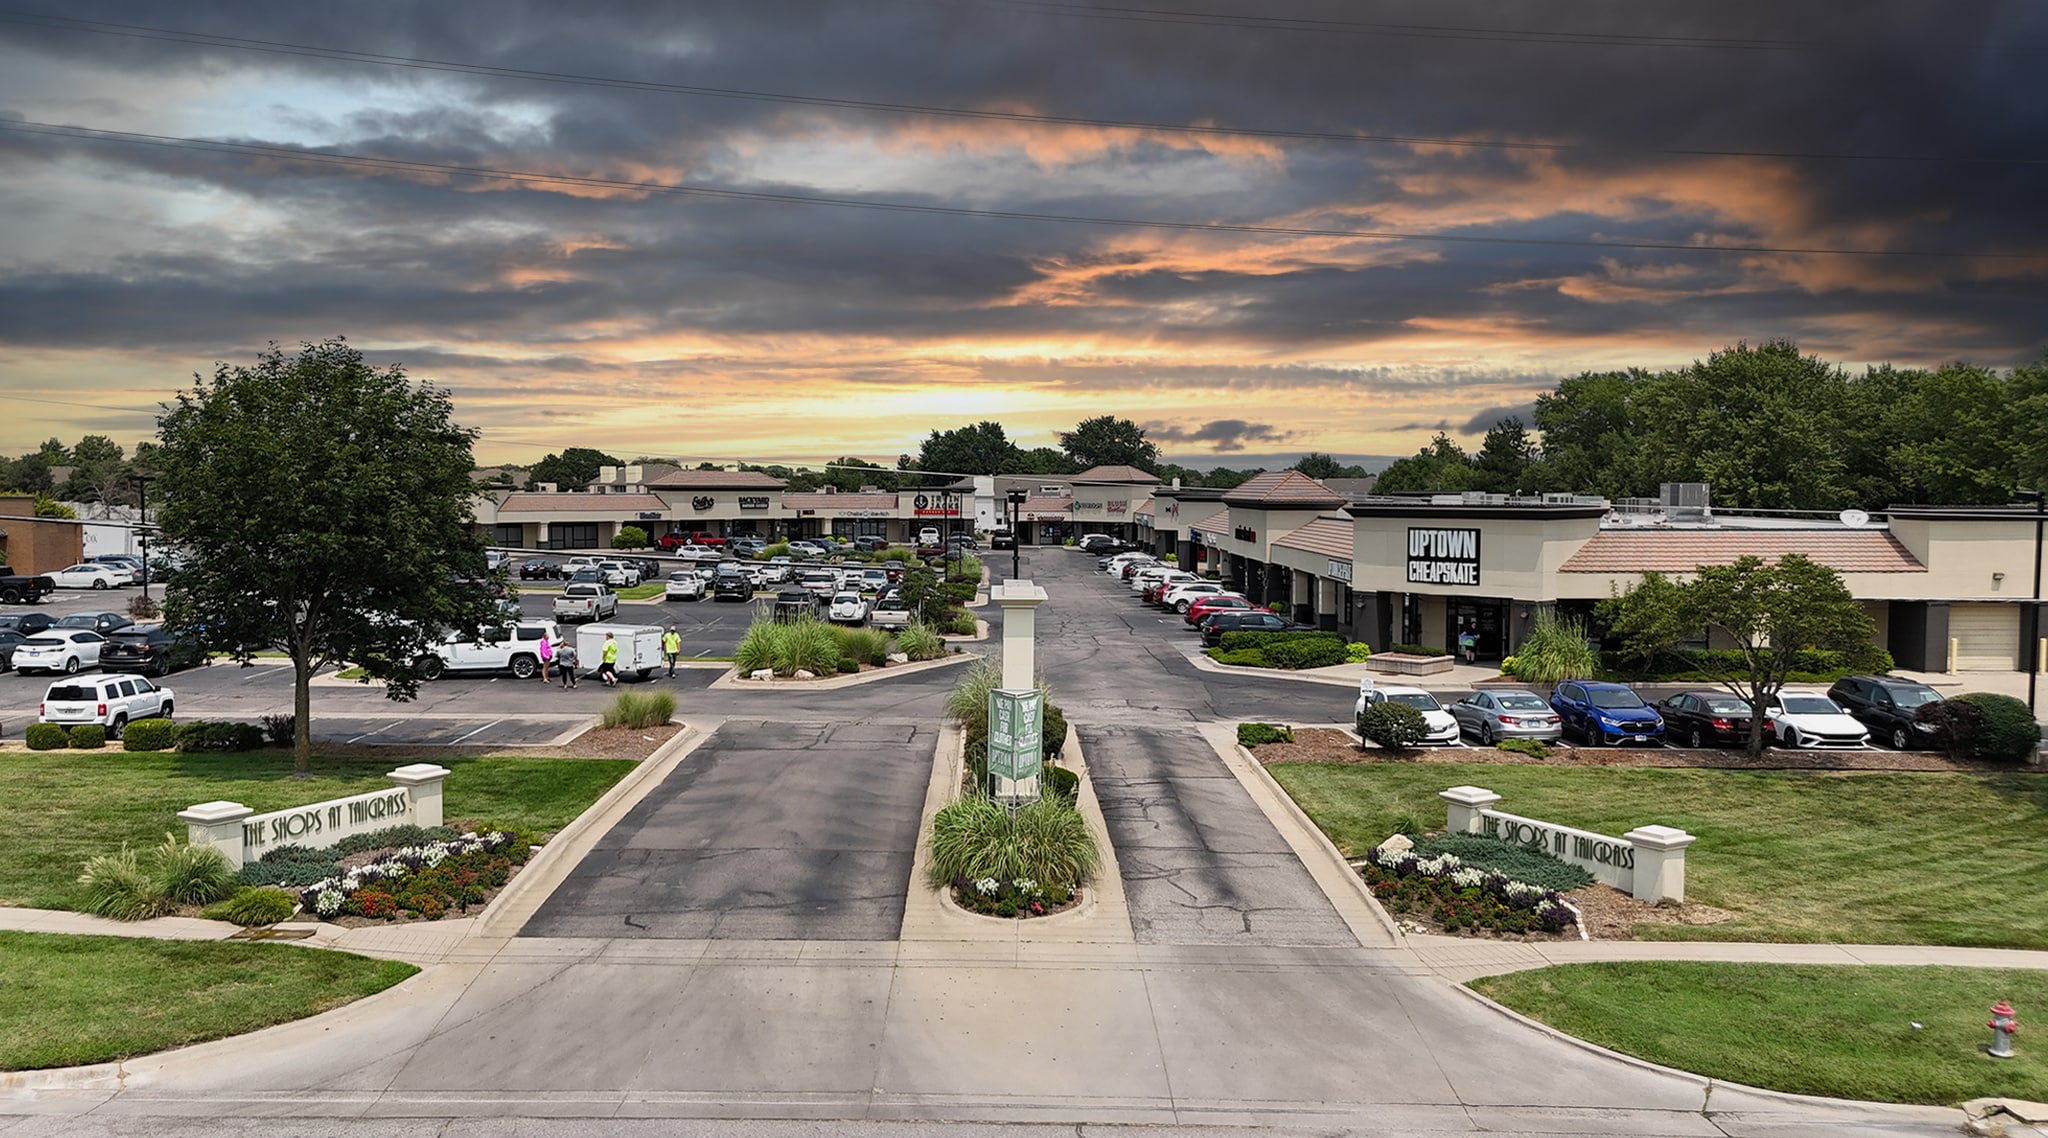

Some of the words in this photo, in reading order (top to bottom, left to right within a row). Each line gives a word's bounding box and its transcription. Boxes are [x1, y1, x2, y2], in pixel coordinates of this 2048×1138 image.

[1409, 530, 1476, 558] UPTOWN
[1409, 561, 1477, 584] CHEAPSKATE
[243, 820, 265, 847] THE
[272, 809, 322, 841] SHOPS
[328, 804, 342, 829] AT
[1482, 814, 1500, 833] THE
[1505, 820, 1548, 850] SHOPS
[1554, 831, 1568, 854] AT
